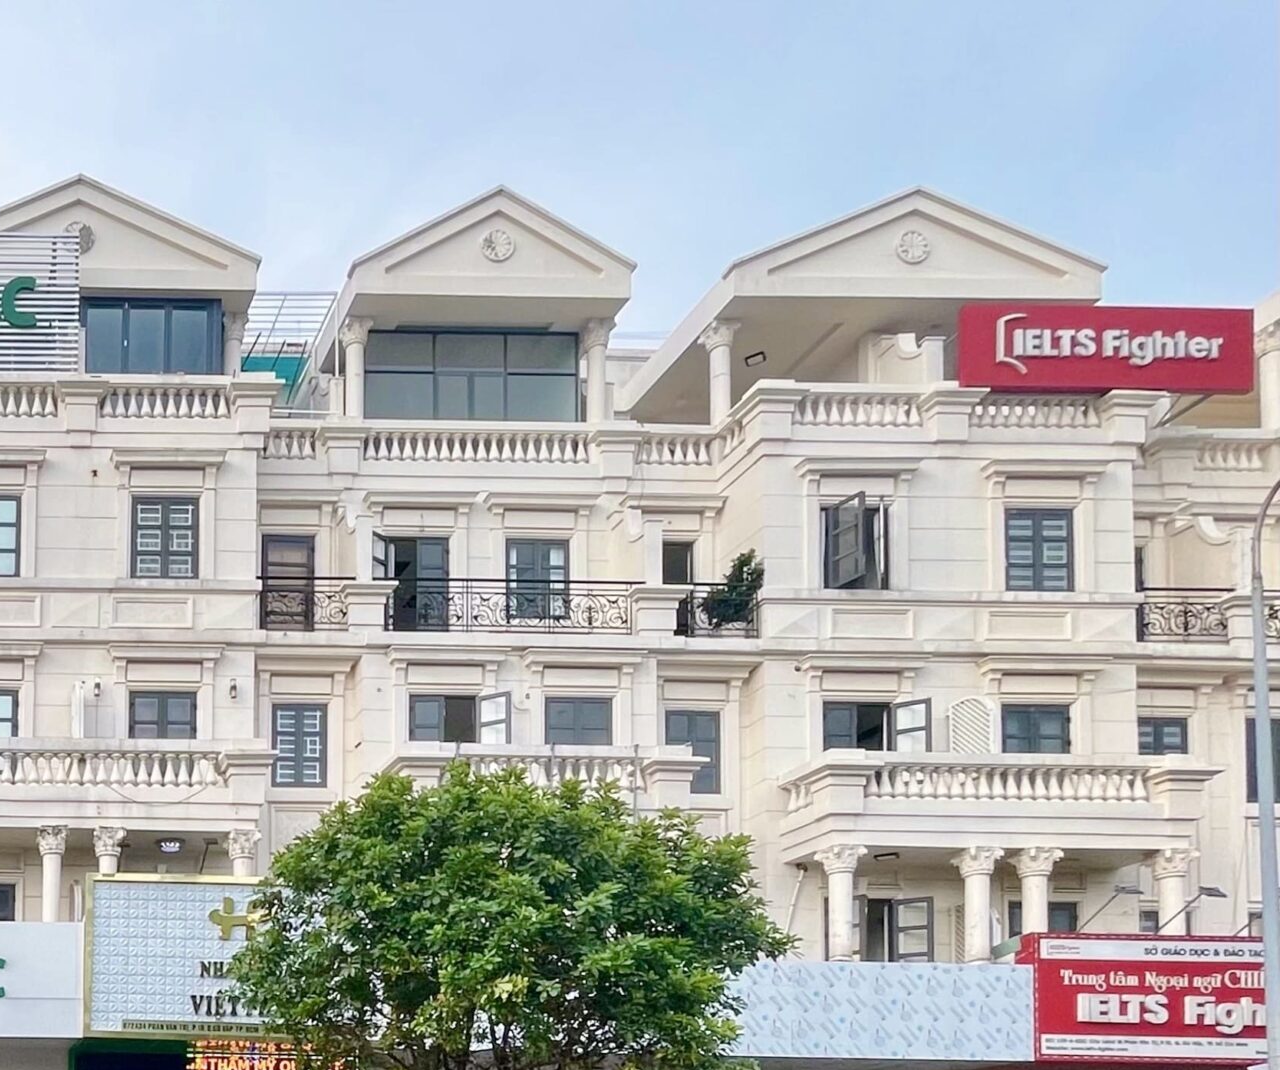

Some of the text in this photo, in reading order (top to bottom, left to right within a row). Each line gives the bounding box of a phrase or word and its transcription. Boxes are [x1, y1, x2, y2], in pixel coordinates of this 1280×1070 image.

[1013, 328, 1225, 367] IELTS Fighter
[1059, 968, 1106, 991] Trung
[1109, 969, 1139, 987] tâm
[1144, 970, 1189, 992] Ngoại
[1077, 992, 1266, 1035] IELTS Figh
